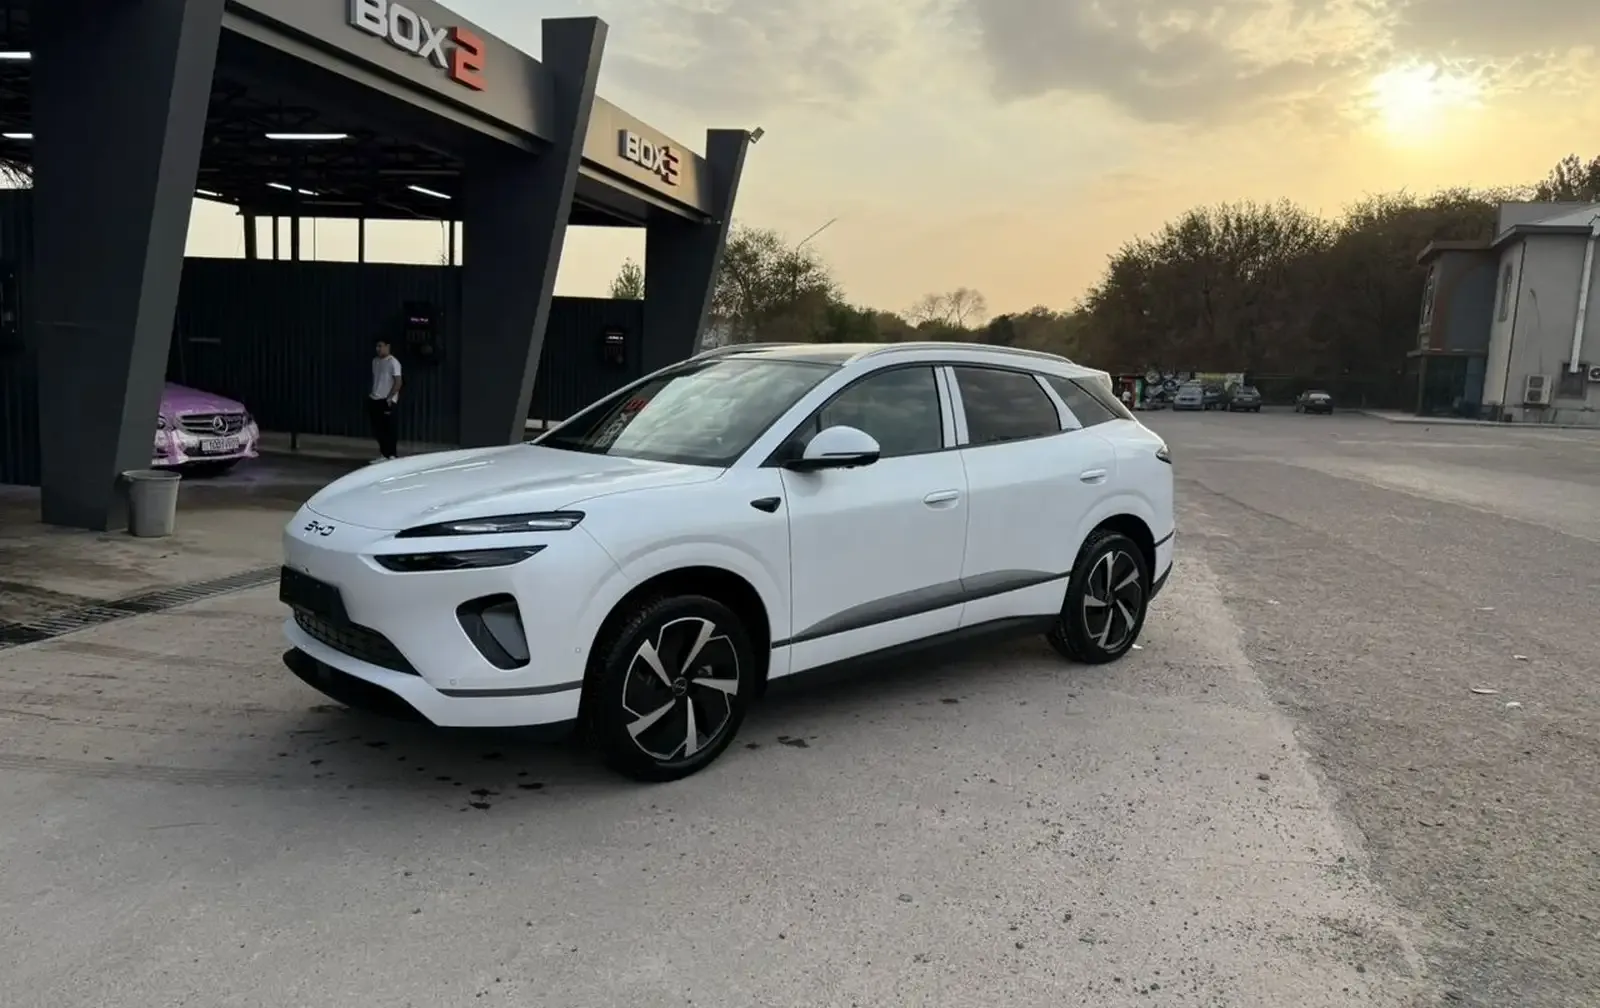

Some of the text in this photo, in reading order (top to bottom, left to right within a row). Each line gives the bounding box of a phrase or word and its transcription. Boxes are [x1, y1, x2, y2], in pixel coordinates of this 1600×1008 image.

[349, 0, 488, 92] BOX 2
[618, 129, 667, 177] BOX
[304, 520, 336, 536] BYD
